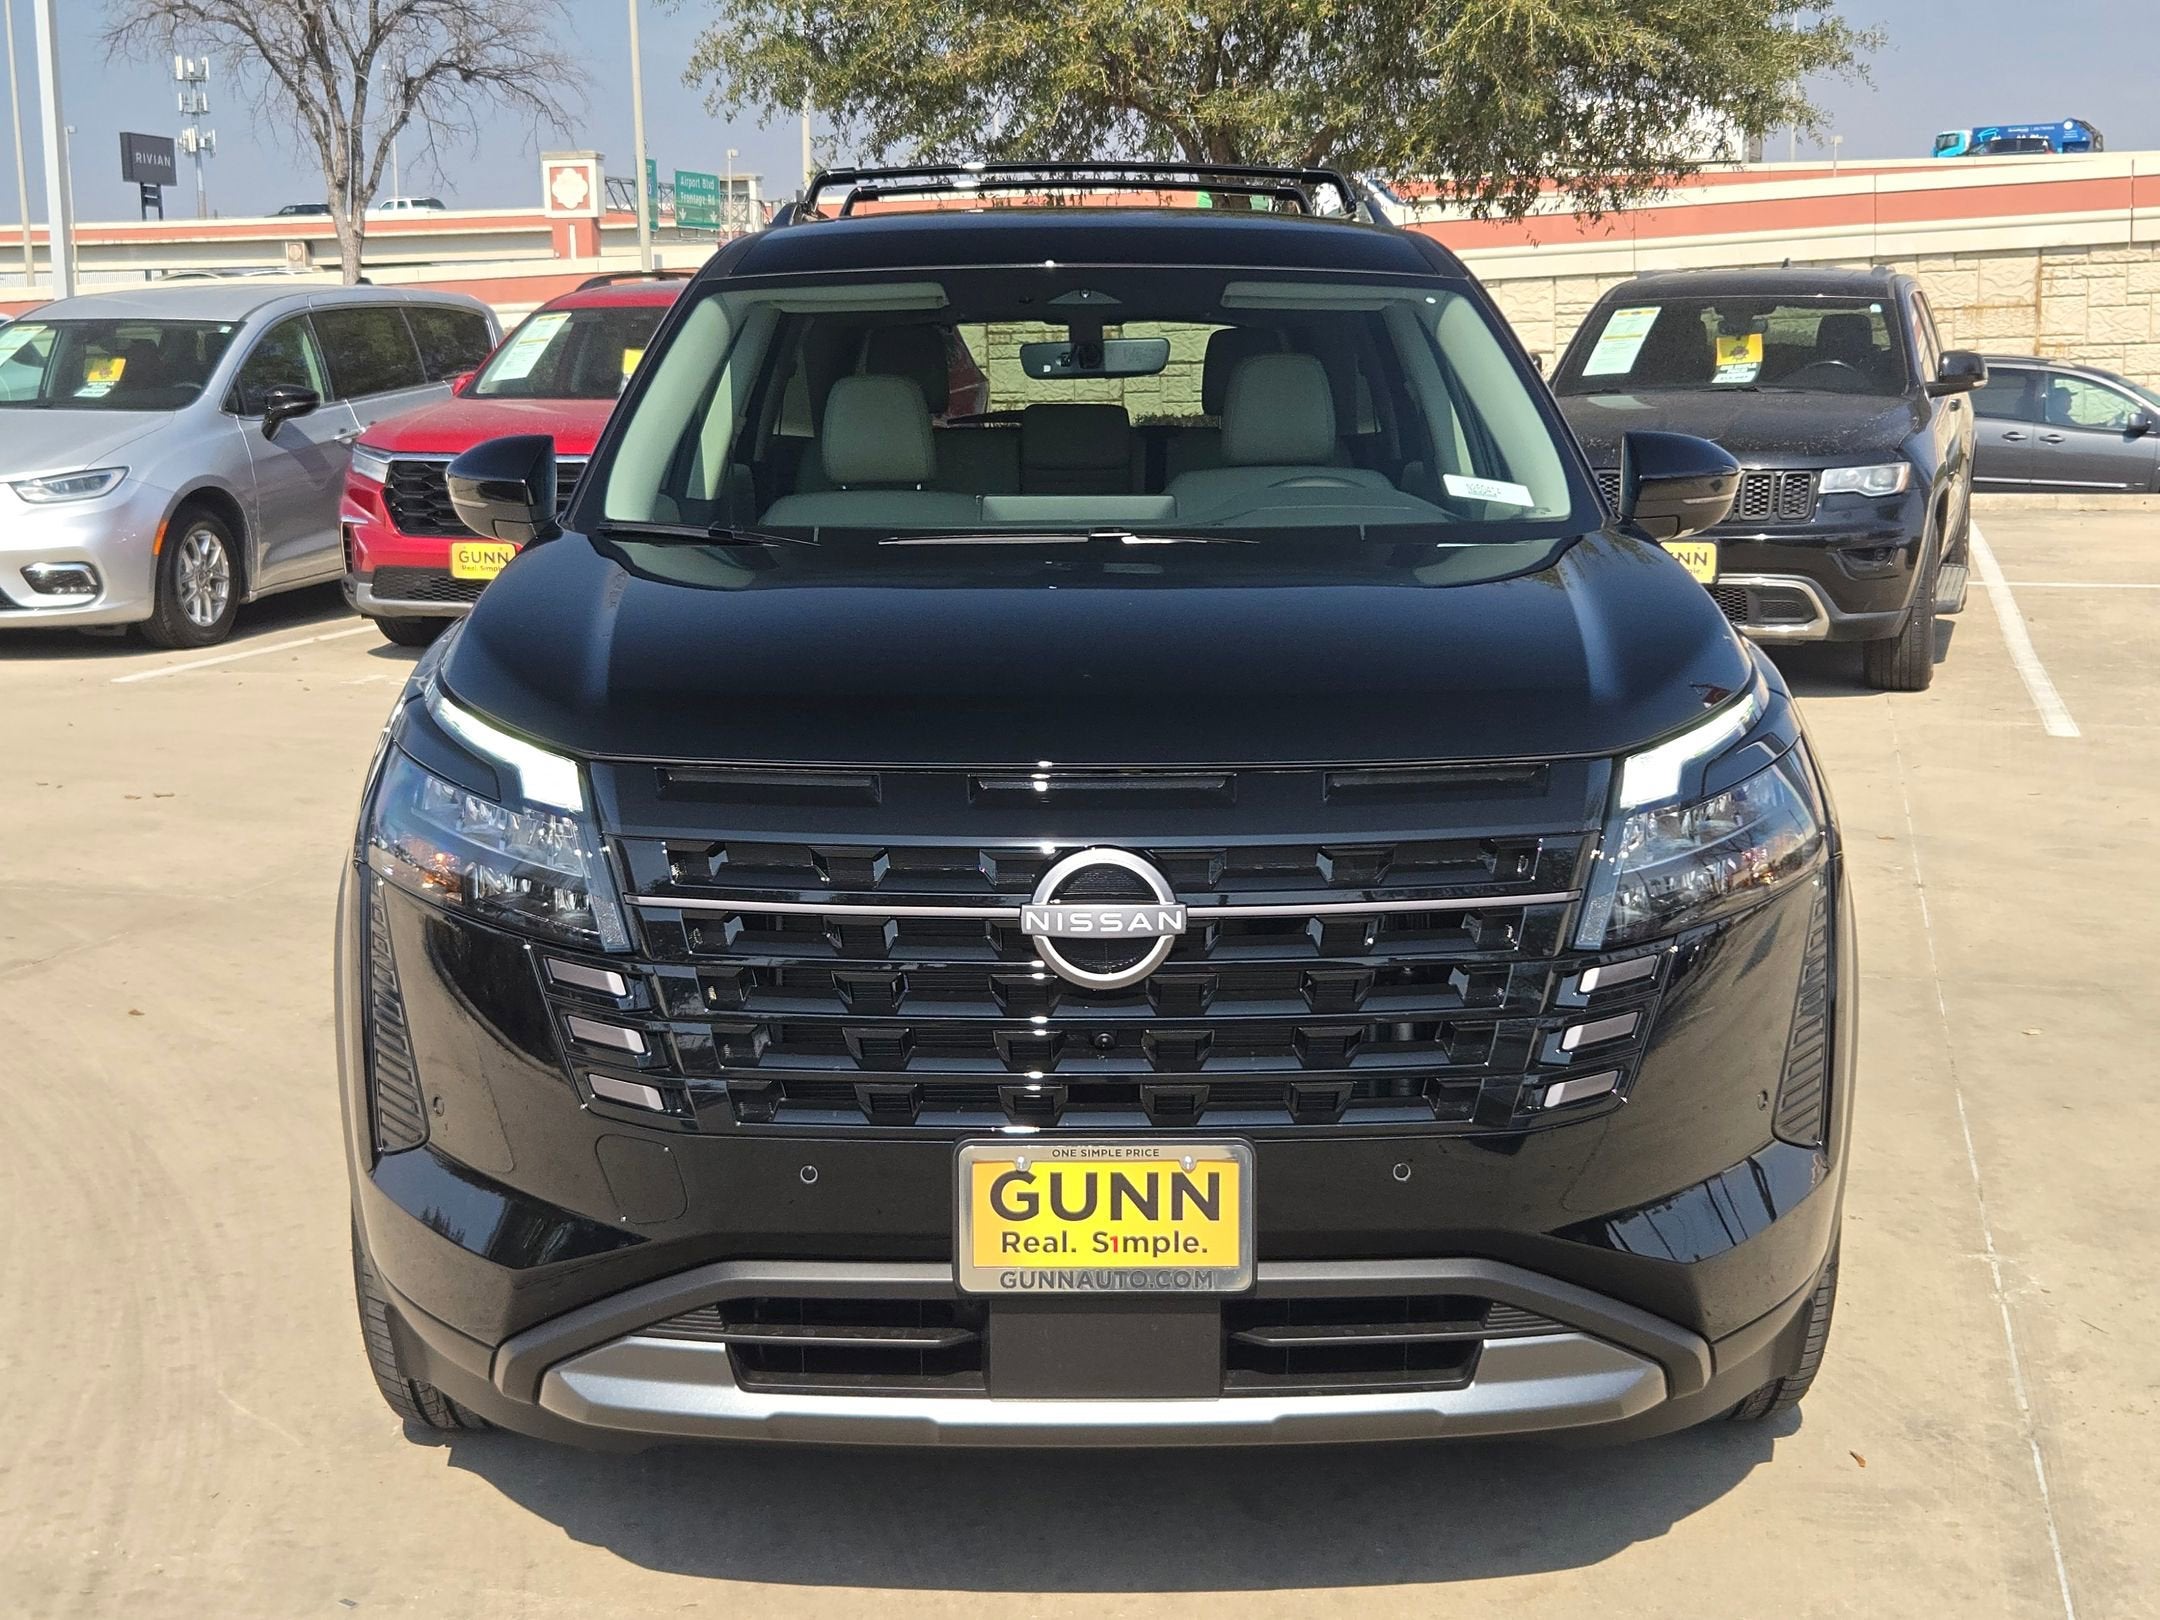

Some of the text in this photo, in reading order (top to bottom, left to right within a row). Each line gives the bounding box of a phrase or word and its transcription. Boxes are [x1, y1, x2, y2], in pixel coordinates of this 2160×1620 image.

[135, 152, 171, 168] RIVIAN
[680, 175, 715, 191] Airport Blvd
[680, 191, 706, 207] Frontage
[458, 550, 509, 565] GUNN
[1671, 551, 1708, 566] NN
[1026, 910, 1182, 932] NISSAN
[1051, 1148, 1160, 1158] ONE SIMPLE PRICE
[989, 1168, 1220, 1222] GUNN
[1001, 1229, 1077, 1253] Real.
[1000, 1270, 1213, 1289] GUNNAUTO.COM
